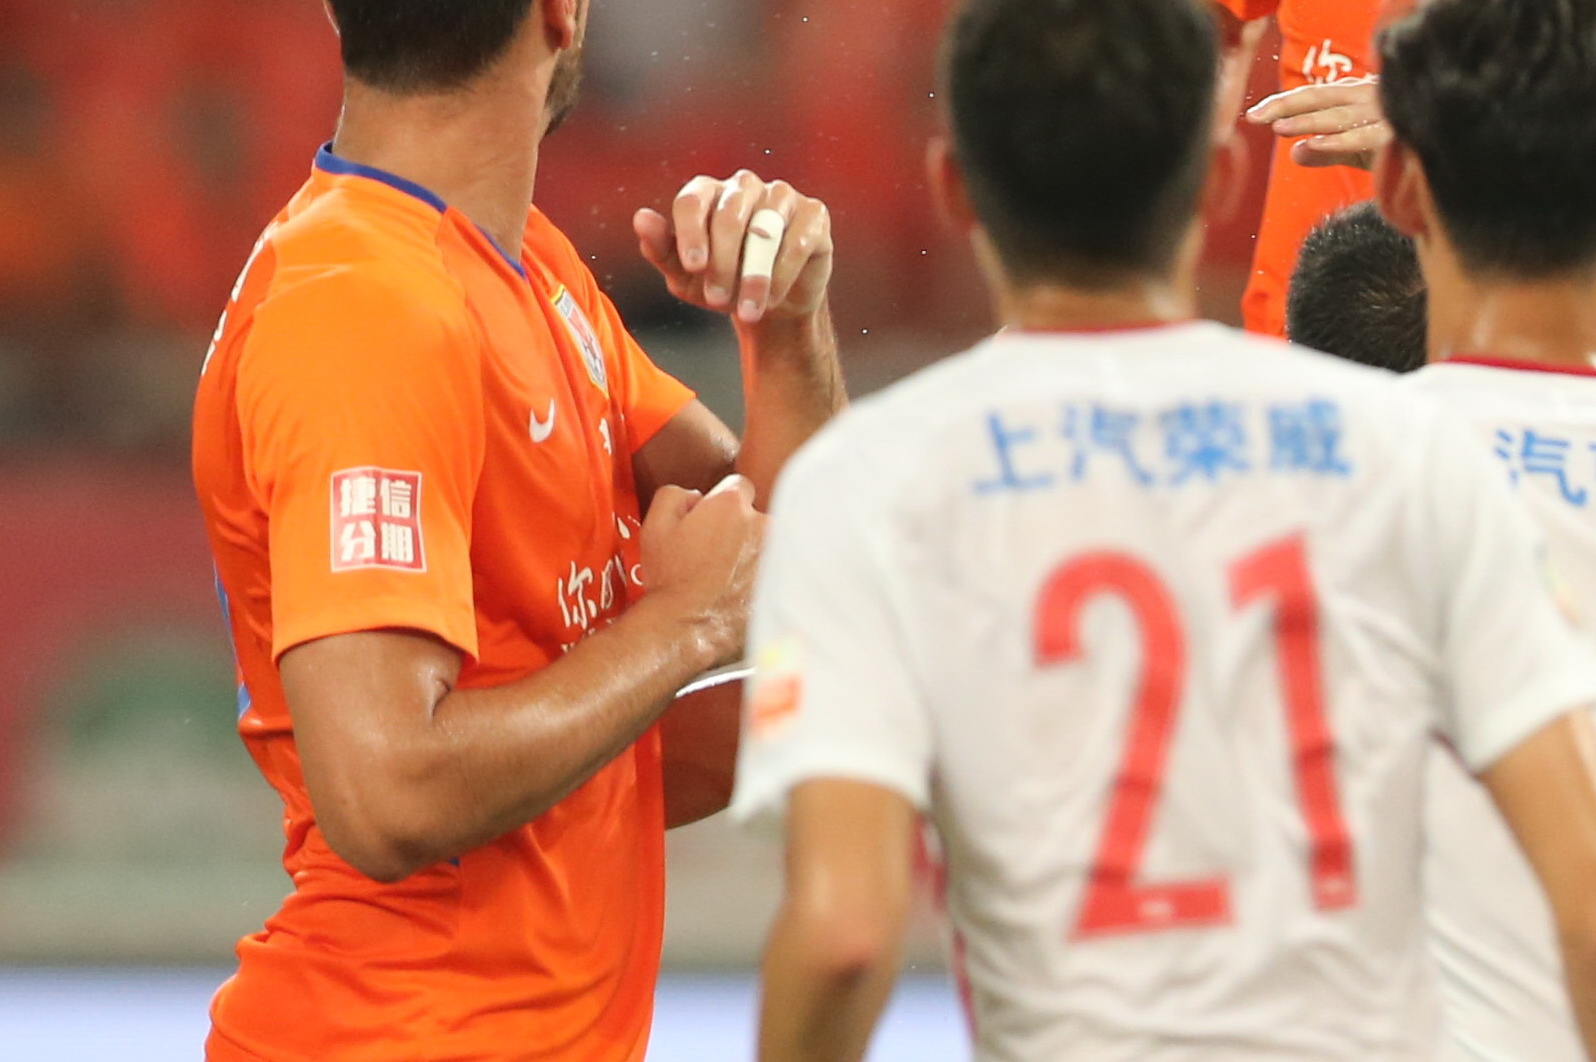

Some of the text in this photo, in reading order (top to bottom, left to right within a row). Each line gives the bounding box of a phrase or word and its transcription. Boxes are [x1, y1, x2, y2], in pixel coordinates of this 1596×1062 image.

[970, 395, 1356, 496] 上汽荣威
[339, 520, 414, 563] 分期
[1030, 530, 1360, 942] 21
